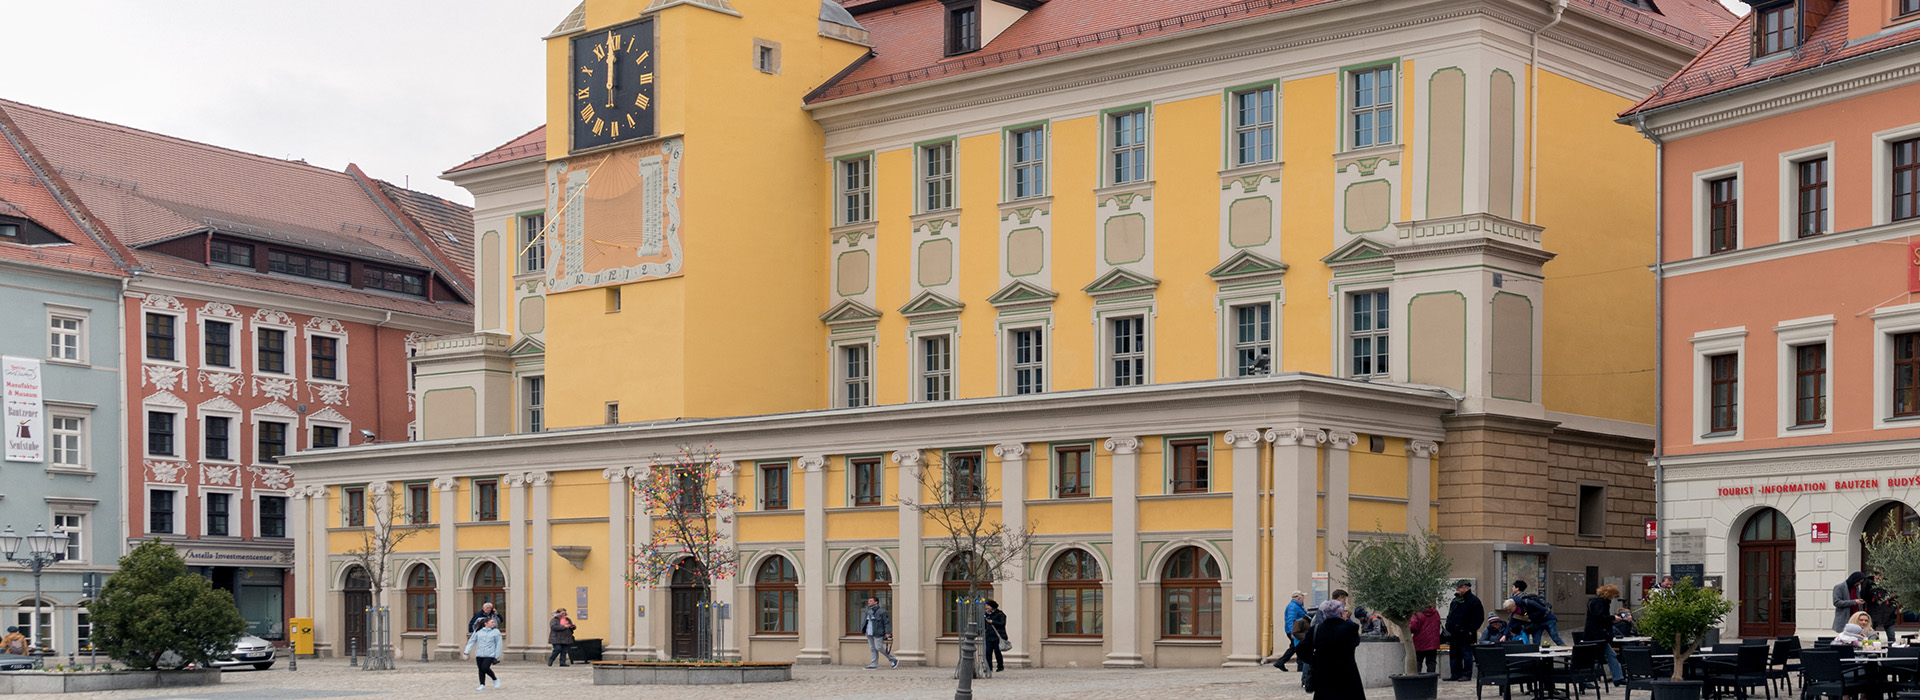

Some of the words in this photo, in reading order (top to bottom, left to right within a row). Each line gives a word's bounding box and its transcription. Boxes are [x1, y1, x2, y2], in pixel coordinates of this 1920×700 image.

[673, 147, 680, 160] 6
[551, 182, 556, 194] 7
[671, 182, 677, 194] 5
[550, 222, 556, 233] 8
[670, 223, 676, 236] 4
[549, 278, 555, 289] 9
[575, 274, 584, 285] 10
[594, 274, 601, 285] 11
[608, 270, 617, 281] 12
[625, 269, 630, 280] 1
[641, 264, 648, 275] 2
[664, 263, 671, 275] 3
[6, 381, 38, 390] Manufaktur
[14, 390, 37, 398] Museum
[9, 440, 39, 450] Senfstube
[1718, 486, 1754, 497] TOURIST
[1835, 479, 1879, 490] BAUTZEN
[215, 552, 273, 560] Investmentcenter
